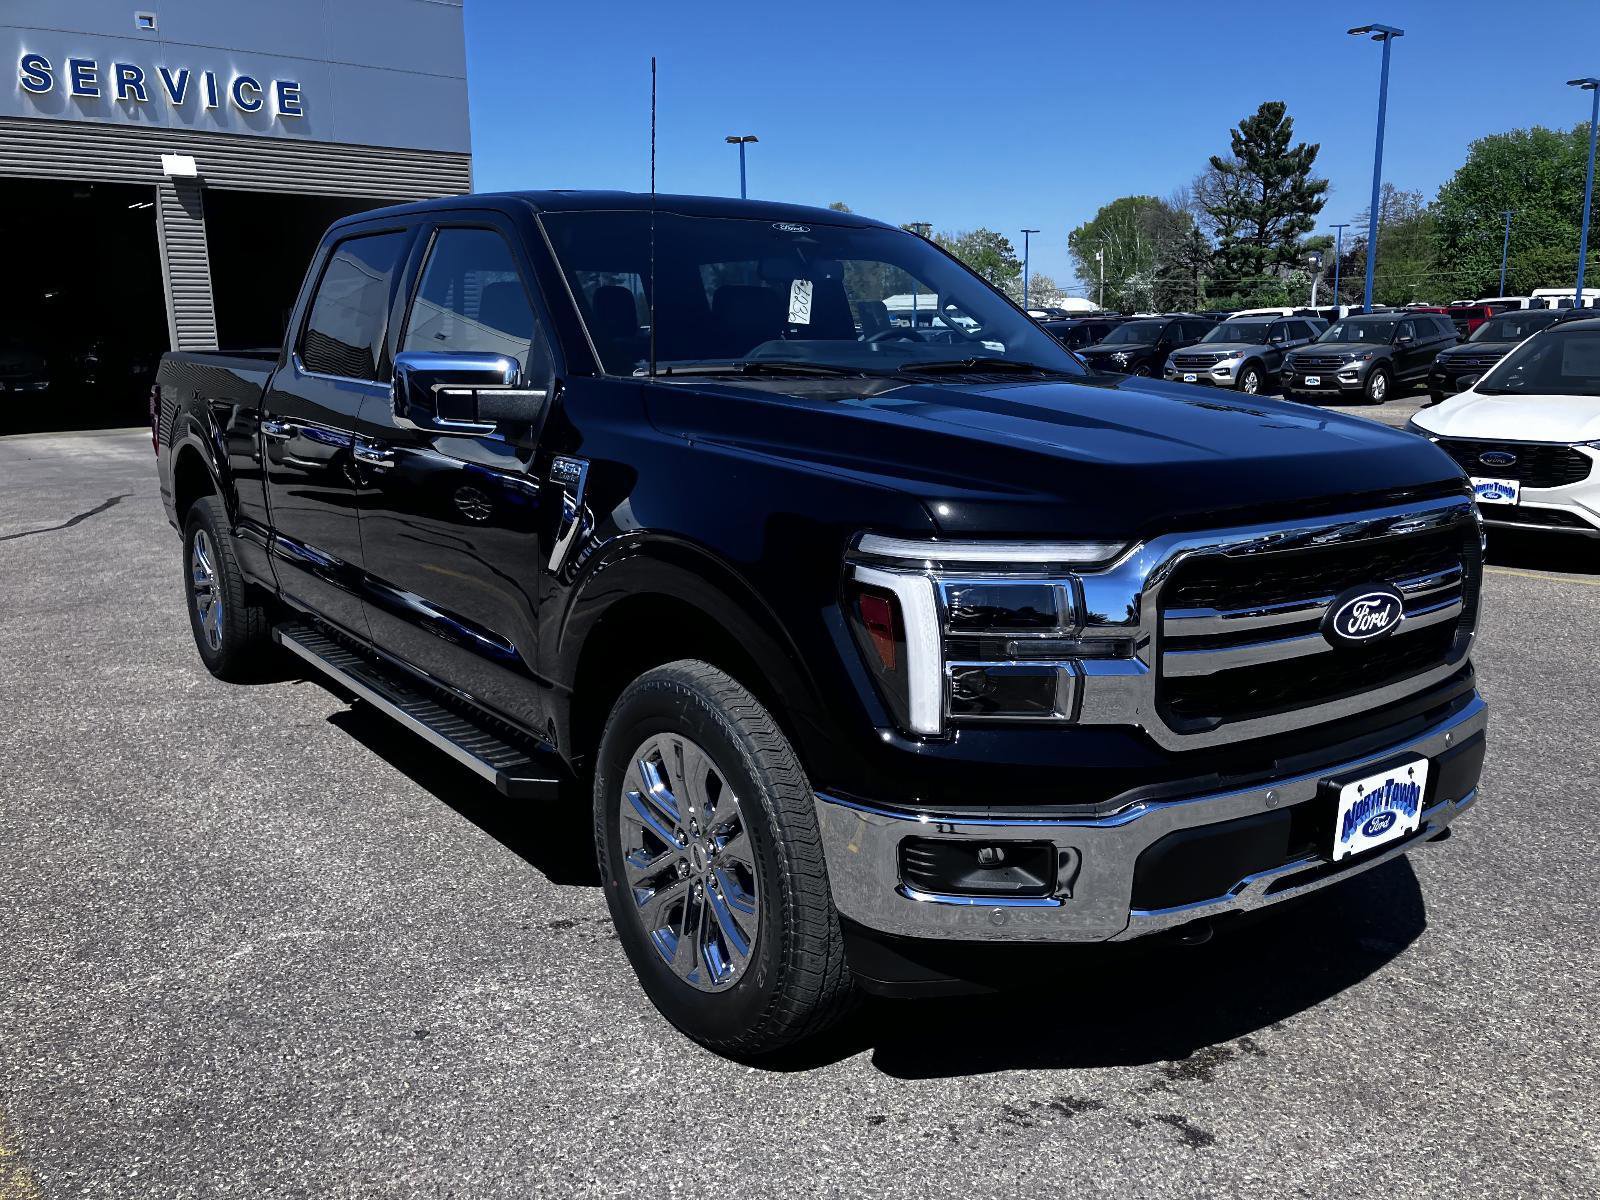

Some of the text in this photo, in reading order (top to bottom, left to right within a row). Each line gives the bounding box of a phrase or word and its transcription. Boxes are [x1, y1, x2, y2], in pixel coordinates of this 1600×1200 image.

[20, 53, 303, 117] SERVICE
[1347, 599, 1391, 634] Ford
[1368, 814, 1391, 833] Ford
